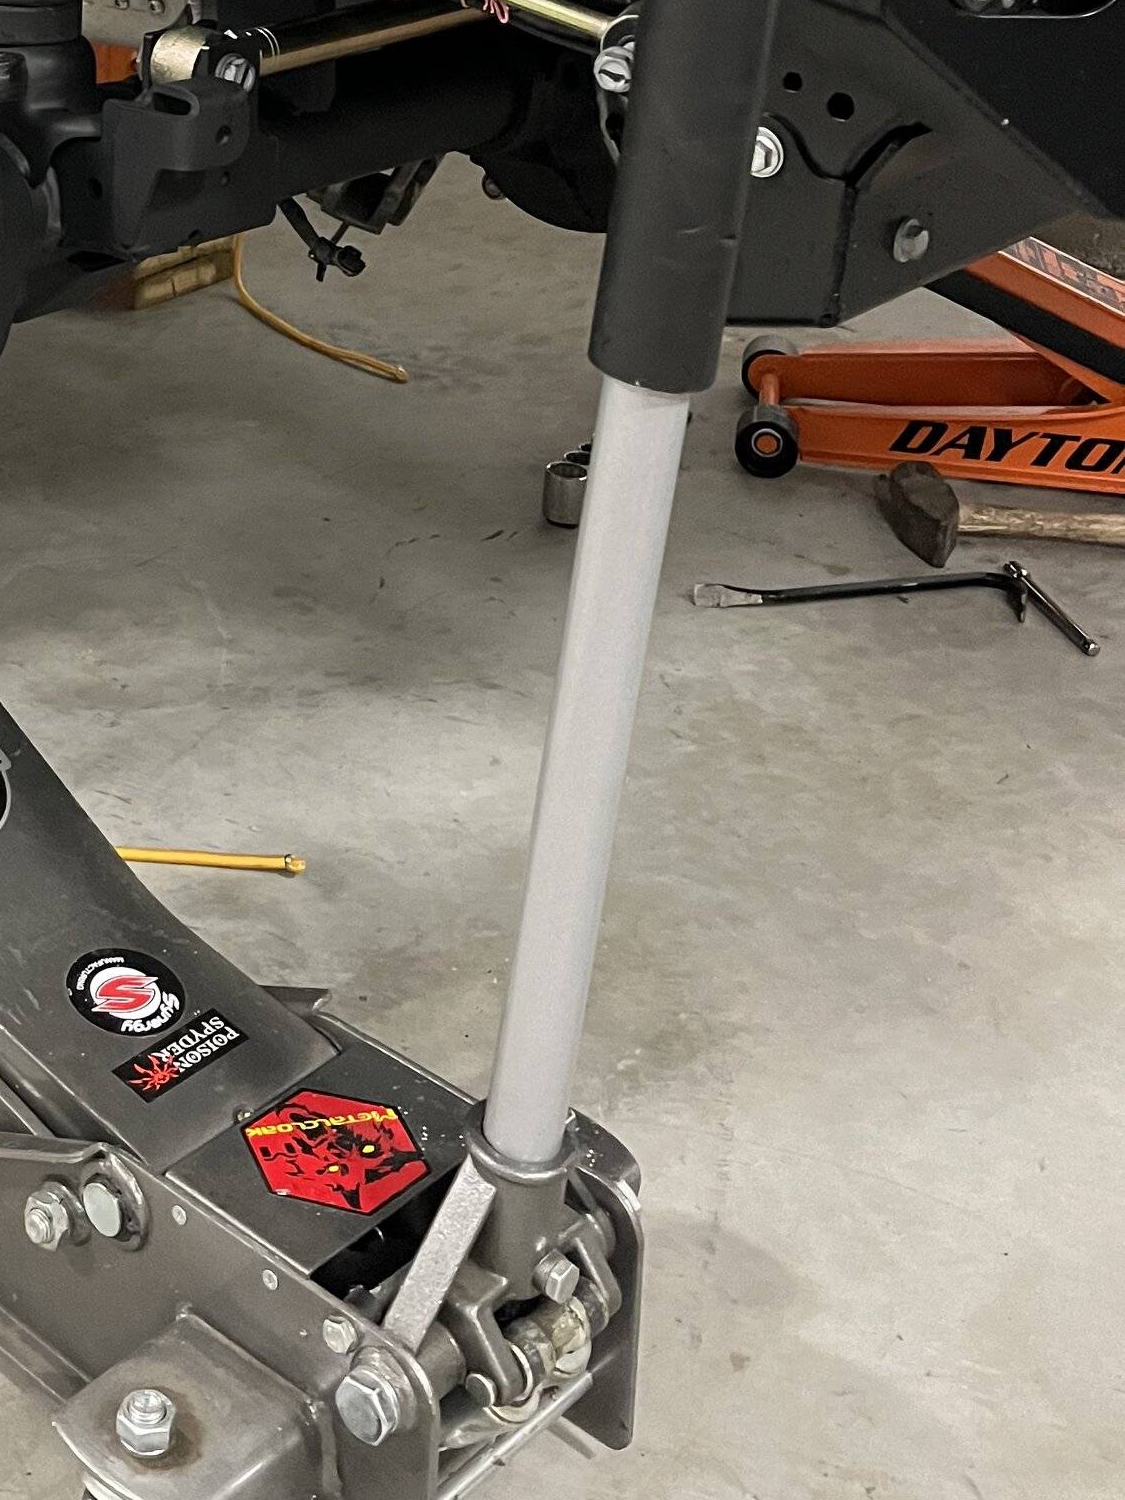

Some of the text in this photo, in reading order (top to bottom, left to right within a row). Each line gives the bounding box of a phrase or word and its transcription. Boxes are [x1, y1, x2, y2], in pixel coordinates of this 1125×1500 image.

[889, 419, 1125, 475] DAYTO
[120, 991, 180, 1033] Synergy
[149, 1016, 225, 1062] SPYDER
[173, 1026, 240, 1073] POISON
